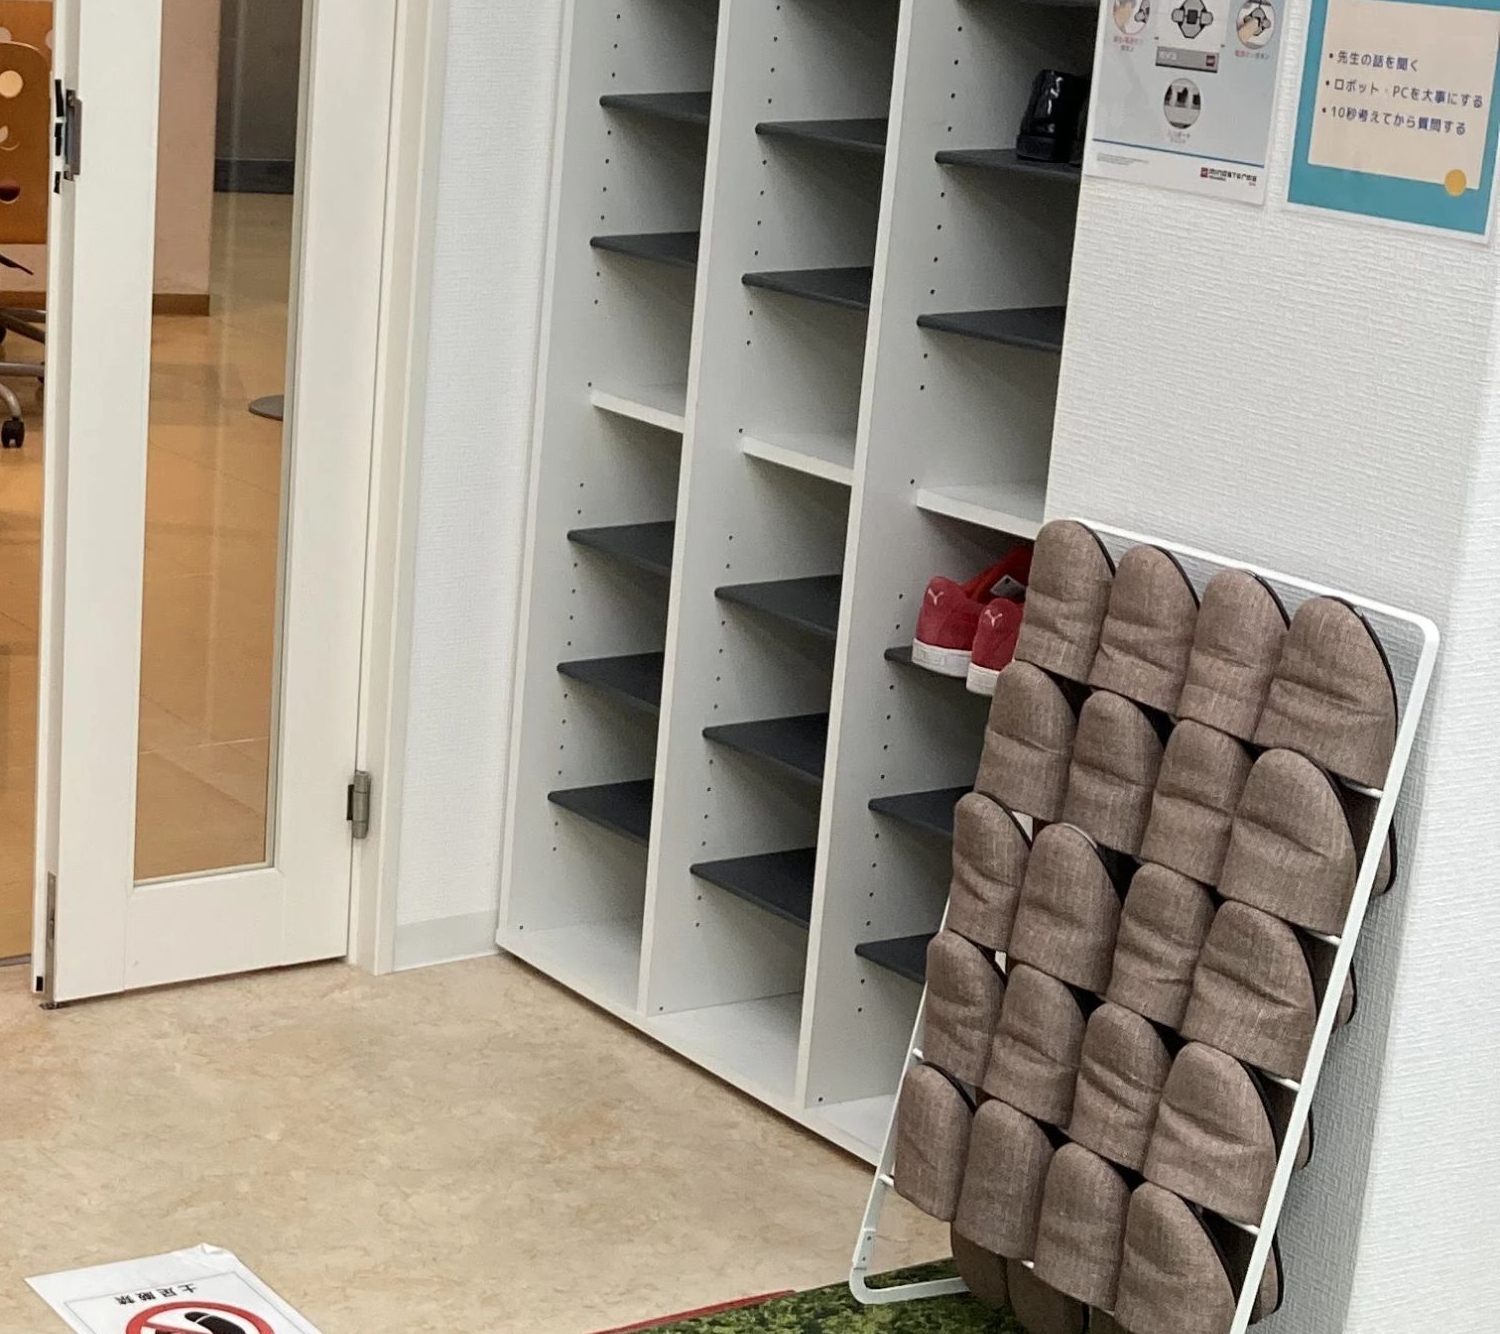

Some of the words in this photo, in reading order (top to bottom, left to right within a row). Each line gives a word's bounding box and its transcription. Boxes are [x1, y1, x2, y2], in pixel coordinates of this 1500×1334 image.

[1337, 50, 1419, 72] 先生の話を聞く
[1331, 106, 1466, 135] 10秒考えてから質問する
